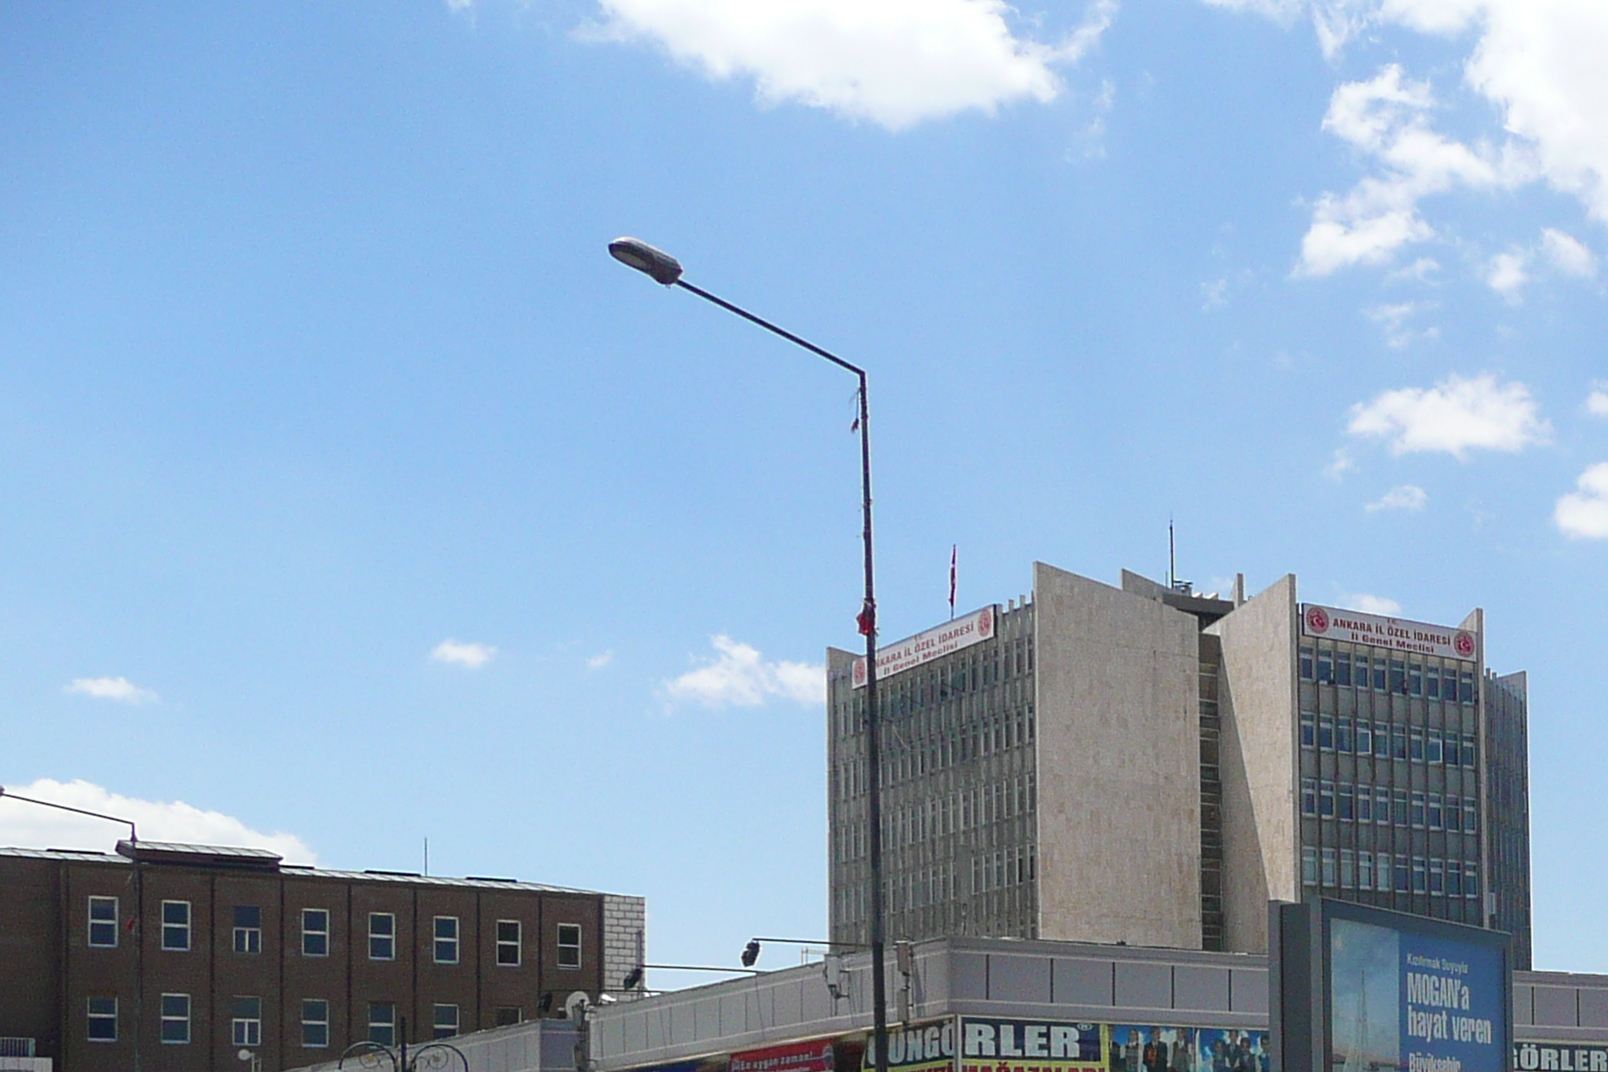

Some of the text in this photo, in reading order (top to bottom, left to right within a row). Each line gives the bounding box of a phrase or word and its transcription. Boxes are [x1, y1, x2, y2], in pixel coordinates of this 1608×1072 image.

[876, 621, 974, 668] NKARA İL ÖZEL İDARESİ
[1333, 617, 1451, 647] ANKARA İL ÖZEL İDARESİ
[1362, 635, 1393, 647] Genel
[1396, 640, 1434, 654] Meclisi
[893, 657, 920, 672] Genel
[922, 641, 958, 661] Meclisi
[1407, 972, 1470, 1011] MOGAN'a
[1408, 1005, 1492, 1045] hayat veren
